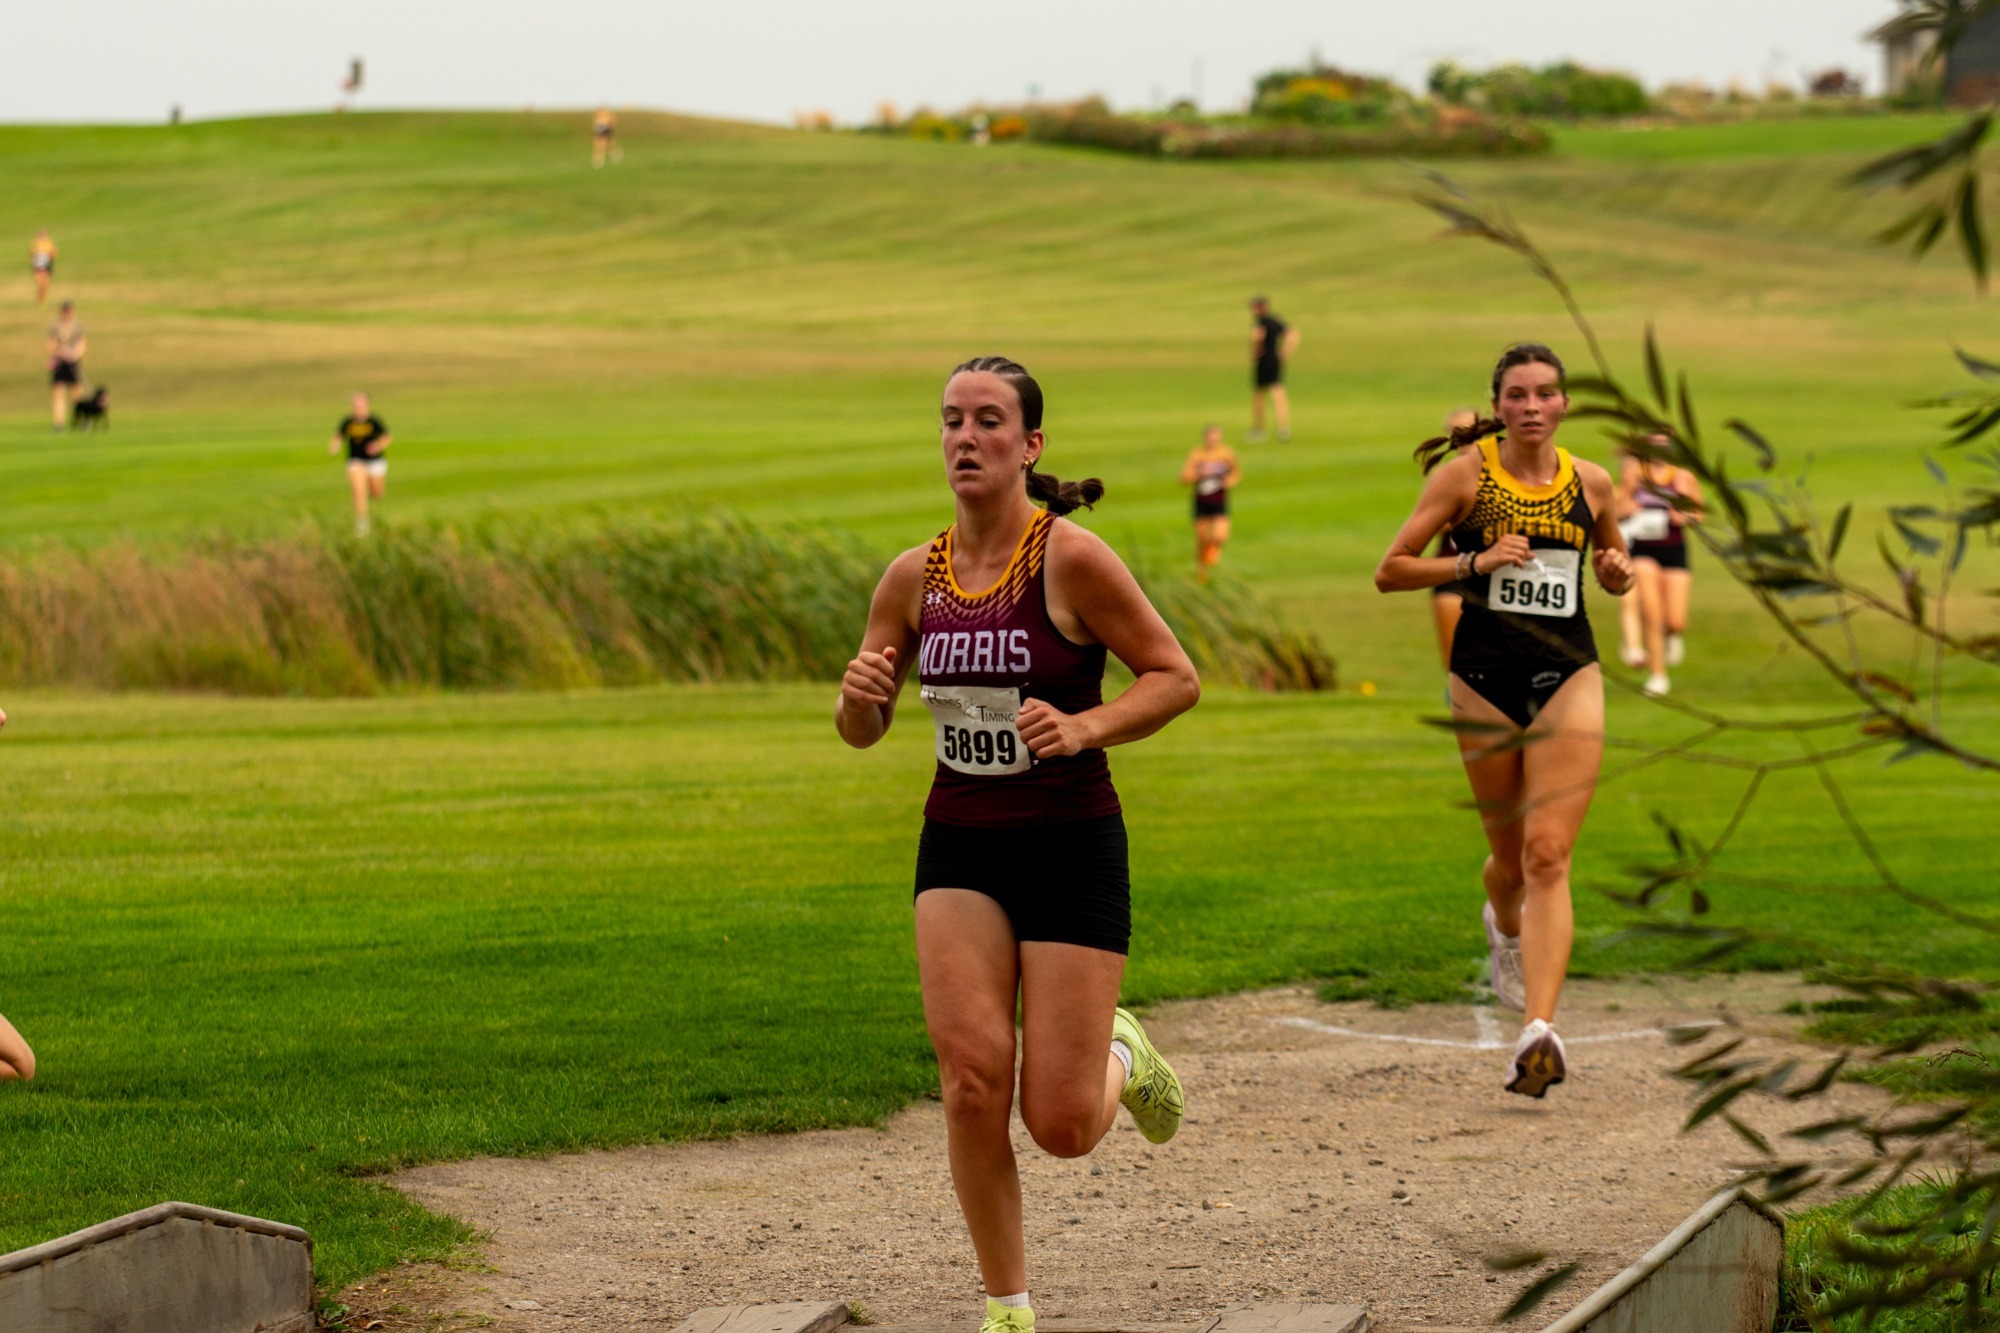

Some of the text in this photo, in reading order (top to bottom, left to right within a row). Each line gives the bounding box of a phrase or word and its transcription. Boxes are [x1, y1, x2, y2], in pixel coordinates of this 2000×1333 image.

[1500, 578, 1566, 610] 5949
[920, 629, 1031, 676] MORRIS
[976, 705, 1015, 723] TIMING
[944, 725, 1017, 765] 5899
